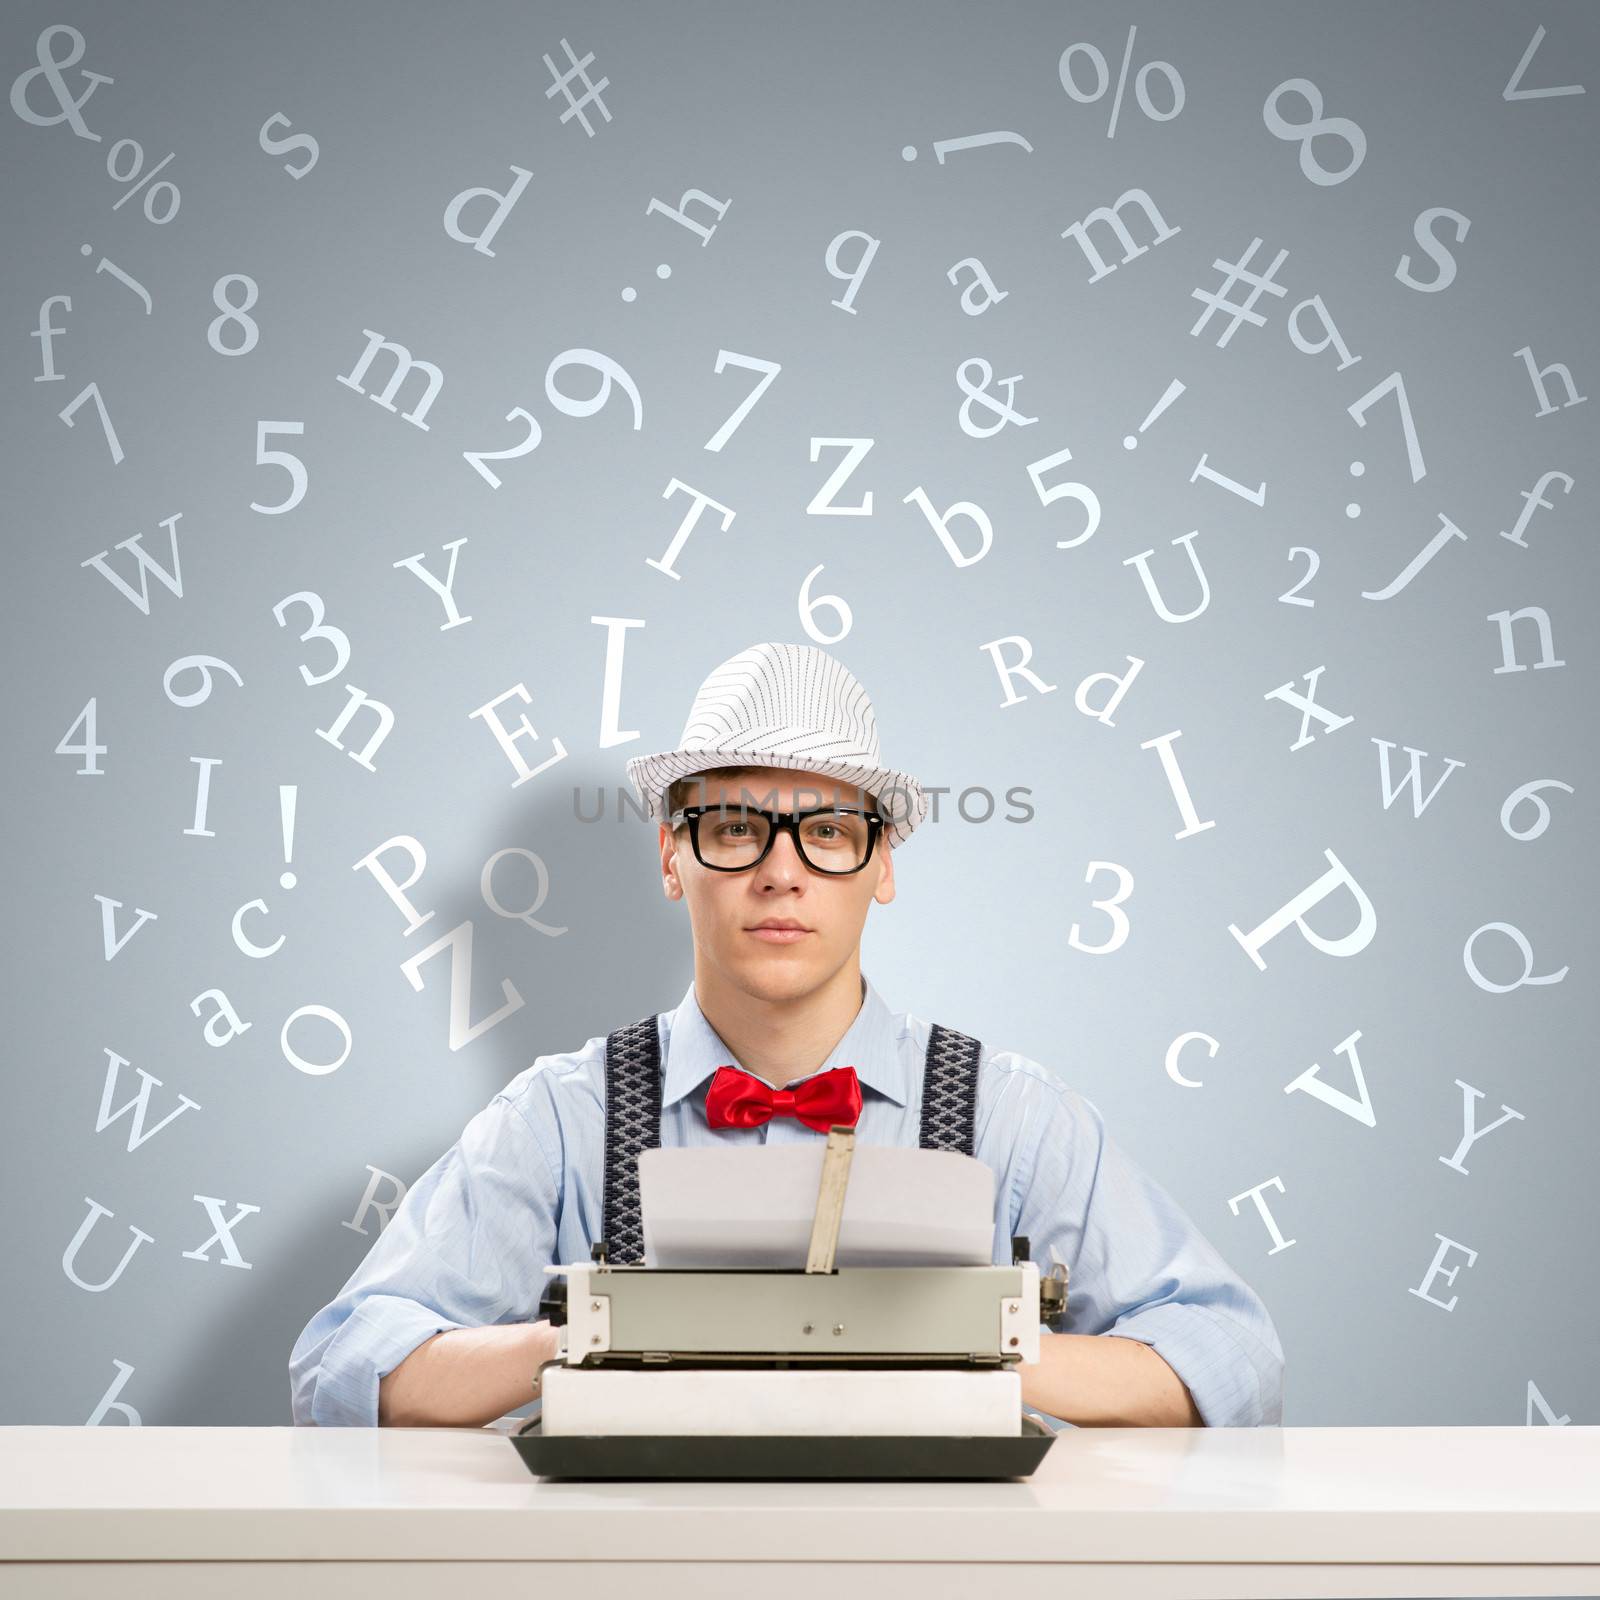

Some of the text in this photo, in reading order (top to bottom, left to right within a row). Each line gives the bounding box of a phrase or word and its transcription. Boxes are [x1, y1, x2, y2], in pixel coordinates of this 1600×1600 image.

[10, 25, 114, 142] &
[543, 38, 612, 137] #
[1059, 25, 1185, 138] %
[1263, 78, 1367, 186] 8
[107, 139, 180, 224] %
[444, 165, 533, 257] d
[646, 189, 732, 247] h
[825, 230, 880, 315] q
[1061, 189, 1181, 284] m
[208, 274, 259, 356] 8
[947, 258, 1009, 316] a
[1190, 237, 1289, 348] #
[31, 296, 72, 382] f
[1288, 294, 1362, 371] q
[58, 382, 124, 464] 7
[336, 329, 443, 431] m
[704, 349, 781, 452] 7
[956, 358, 1039, 438] &
[1123, 378, 1186, 450] !
[1513, 346, 1587, 417] h
[250, 421, 308, 514] 5
[463, 407, 542, 490] 2
[1347, 372, 1426, 483] 7
[645, 478, 736, 580] T
[903, 486, 993, 568] b
[1026, 448, 1101, 549] 5
[1500, 471, 1575, 548] f
[393, 537, 472, 631] Y
[798, 564, 852, 644] 6
[1123, 530, 1210, 623] U
[1278, 547, 1320, 608] 2
[272, 591, 350, 686] 3
[979, 636, 1057, 708] R
[1487, 607, 1566, 674] n
[315, 684, 394, 772] n
[1075, 655, 1144, 727] d
[55, 697, 107, 775] 4
[469, 683, 568, 788] E
[183, 757, 222, 837] I
[1141, 730, 1216, 840] I
[1500, 779, 1574, 841] 6
[280, 785, 297, 889] !
[352, 835, 434, 936] P
[481, 849, 568, 936] Q
[1068, 862, 1134, 954] 3
[1228, 848, 1377, 971] P
[1464, 922, 1569, 993] Q
[190, 989, 252, 1047] a
[1439, 1079, 1525, 1175] Y
[63, 1197, 155, 1292] U
[1228, 1176, 1296, 1255] T
[1408, 1233, 1478, 1312] E
